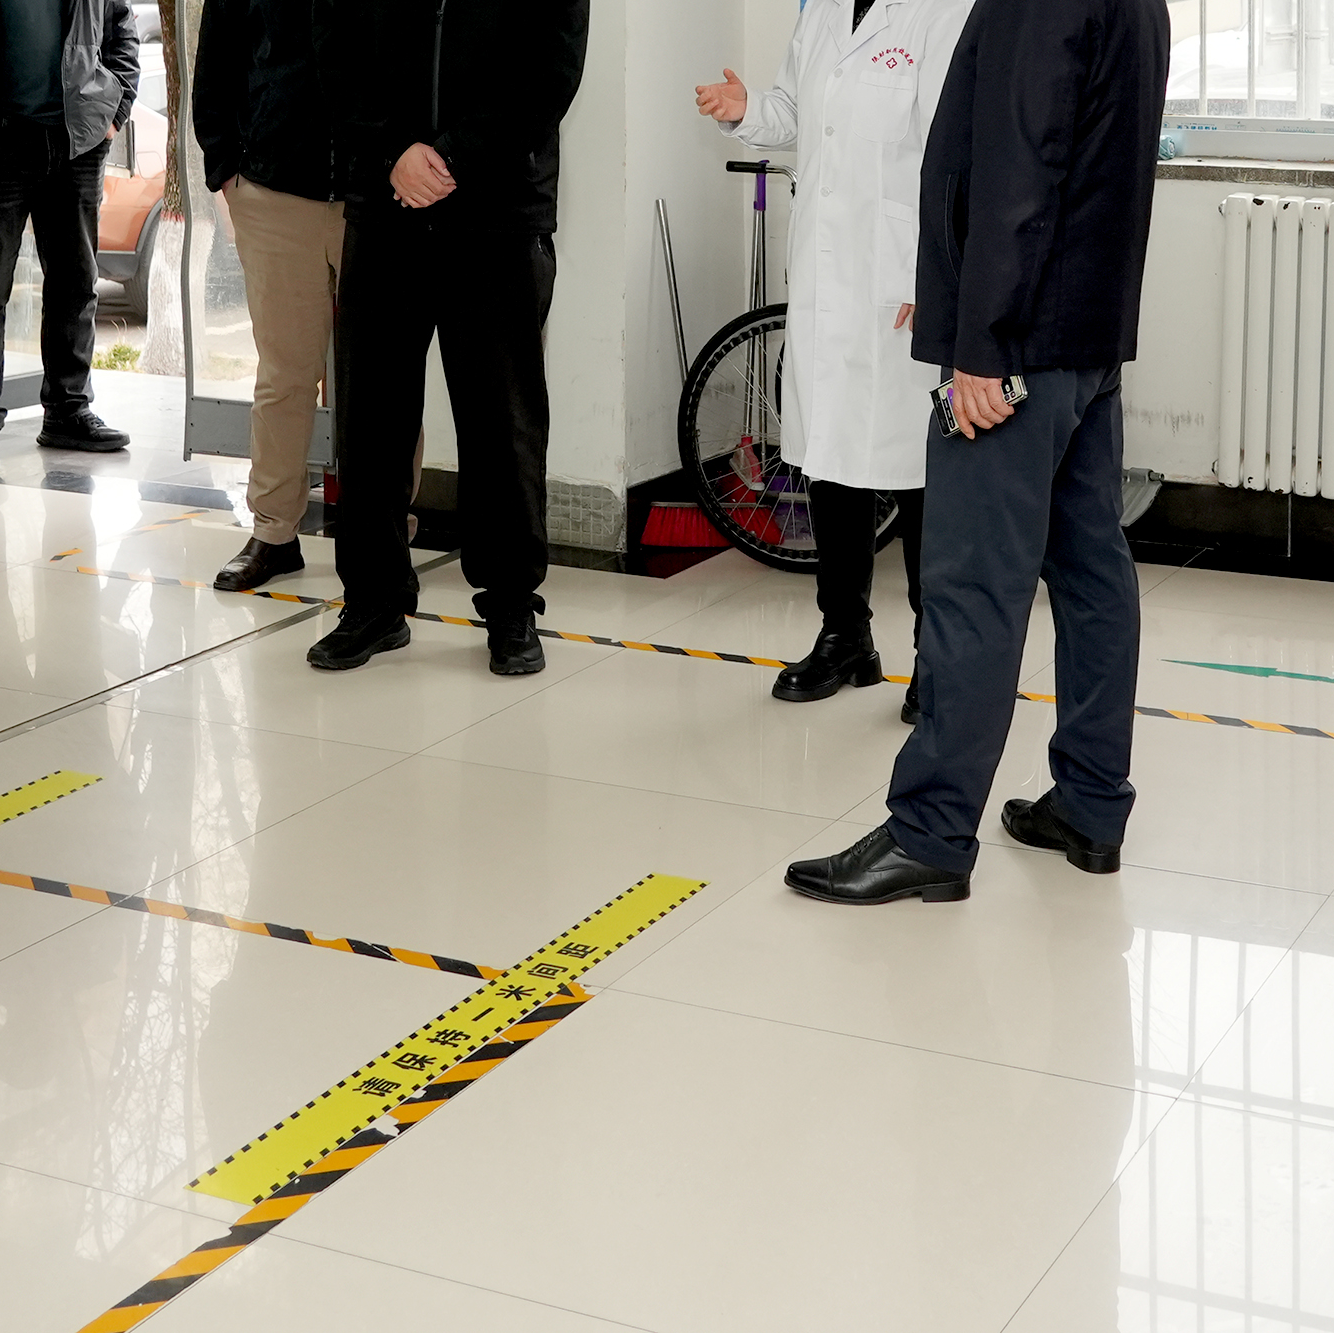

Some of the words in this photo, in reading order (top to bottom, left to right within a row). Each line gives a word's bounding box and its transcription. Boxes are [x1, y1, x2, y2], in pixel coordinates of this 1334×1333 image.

[351, 942, 599, 1097] 请保持一米间距
